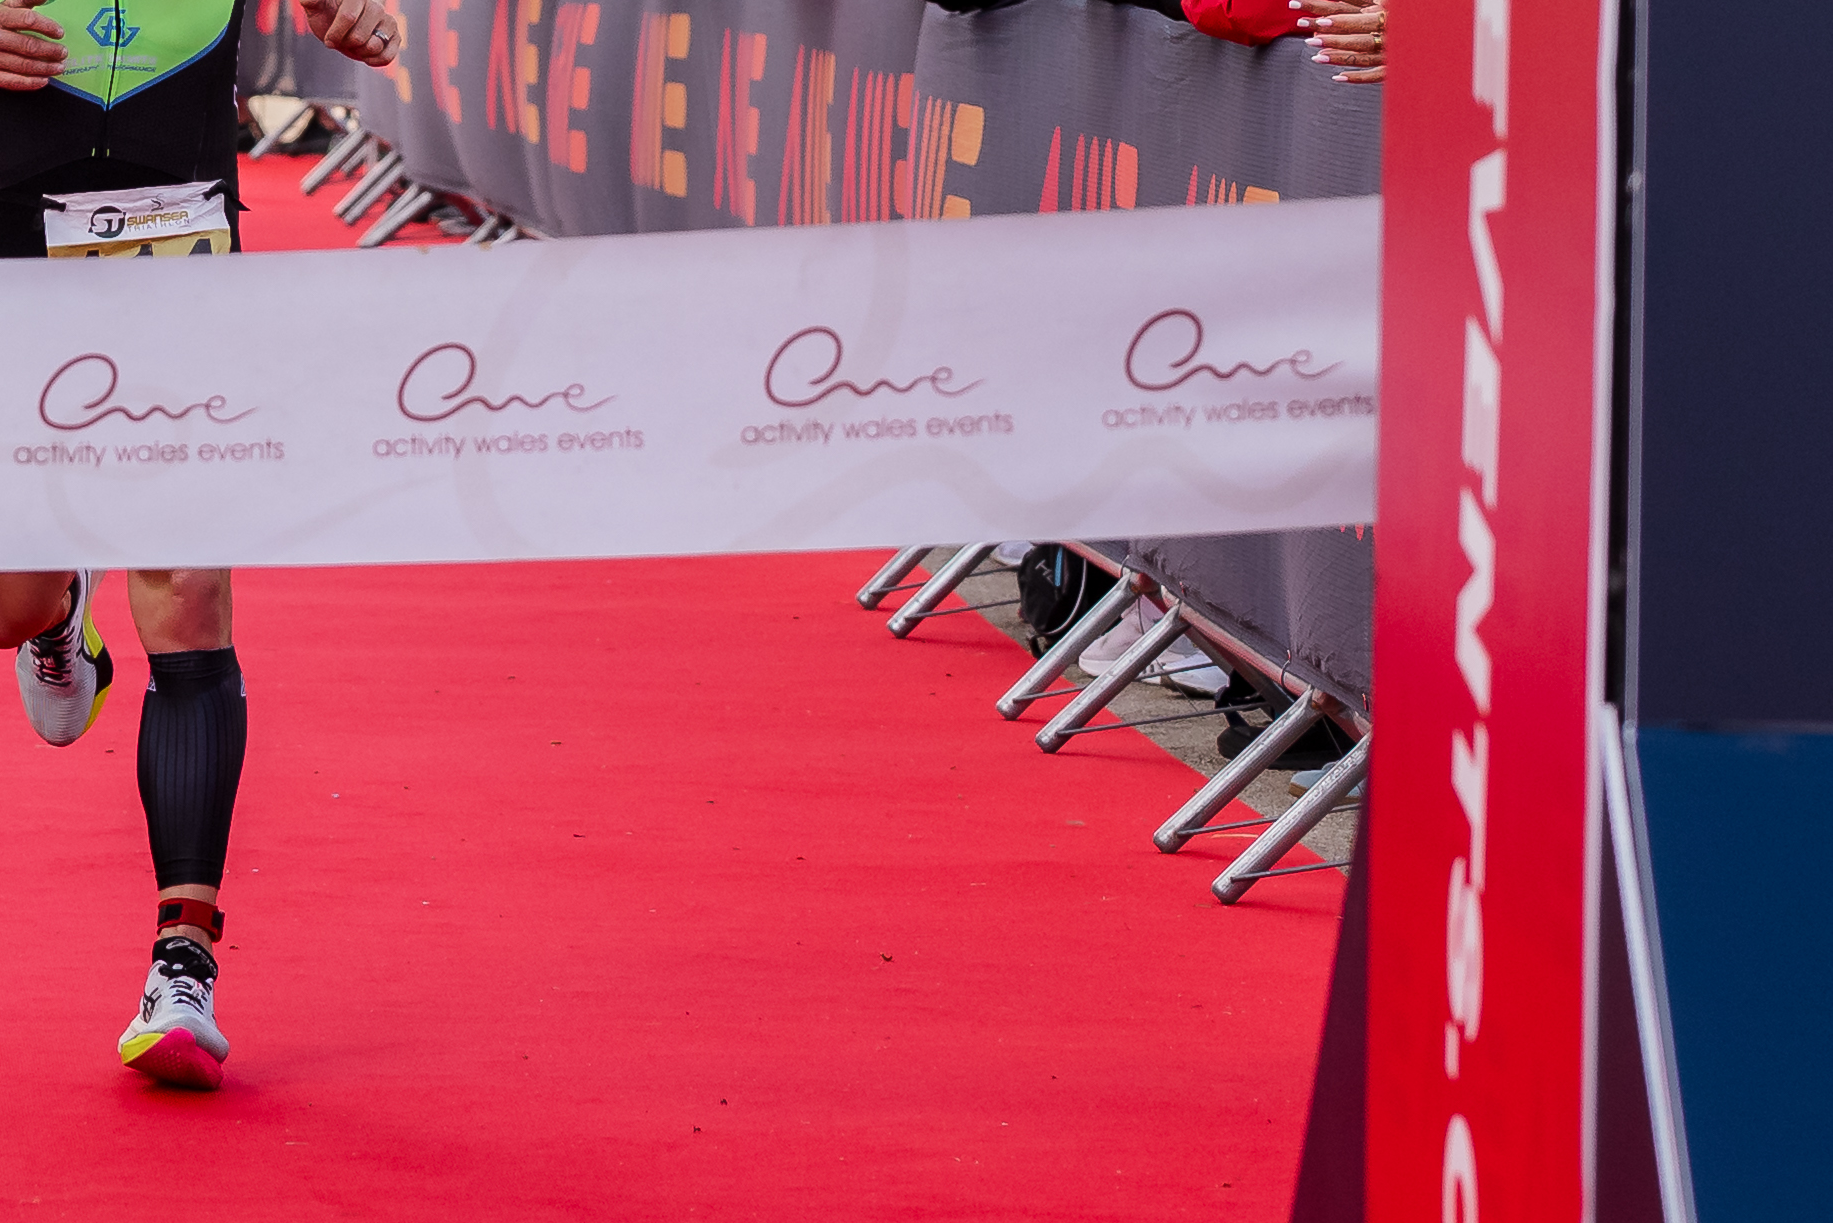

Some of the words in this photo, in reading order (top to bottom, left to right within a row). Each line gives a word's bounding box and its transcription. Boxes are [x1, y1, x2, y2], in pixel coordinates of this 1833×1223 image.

[127, 211, 189, 226] SWANSEA
[740, 415, 836, 448] activity
[842, 414, 918, 439] wales
[924, 409, 1015, 437] events
[1100, 400, 1196, 433] activity
[1203, 396, 1281, 425] wales
[1287, 390, 1377, 421] events
[12, 440, 107, 468] activity
[114, 441, 191, 465] wales
[197, 438, 285, 464] events
[372, 433, 465, 460] activity
[473, 431, 550, 456] wales
[556, 426, 646, 454] events
